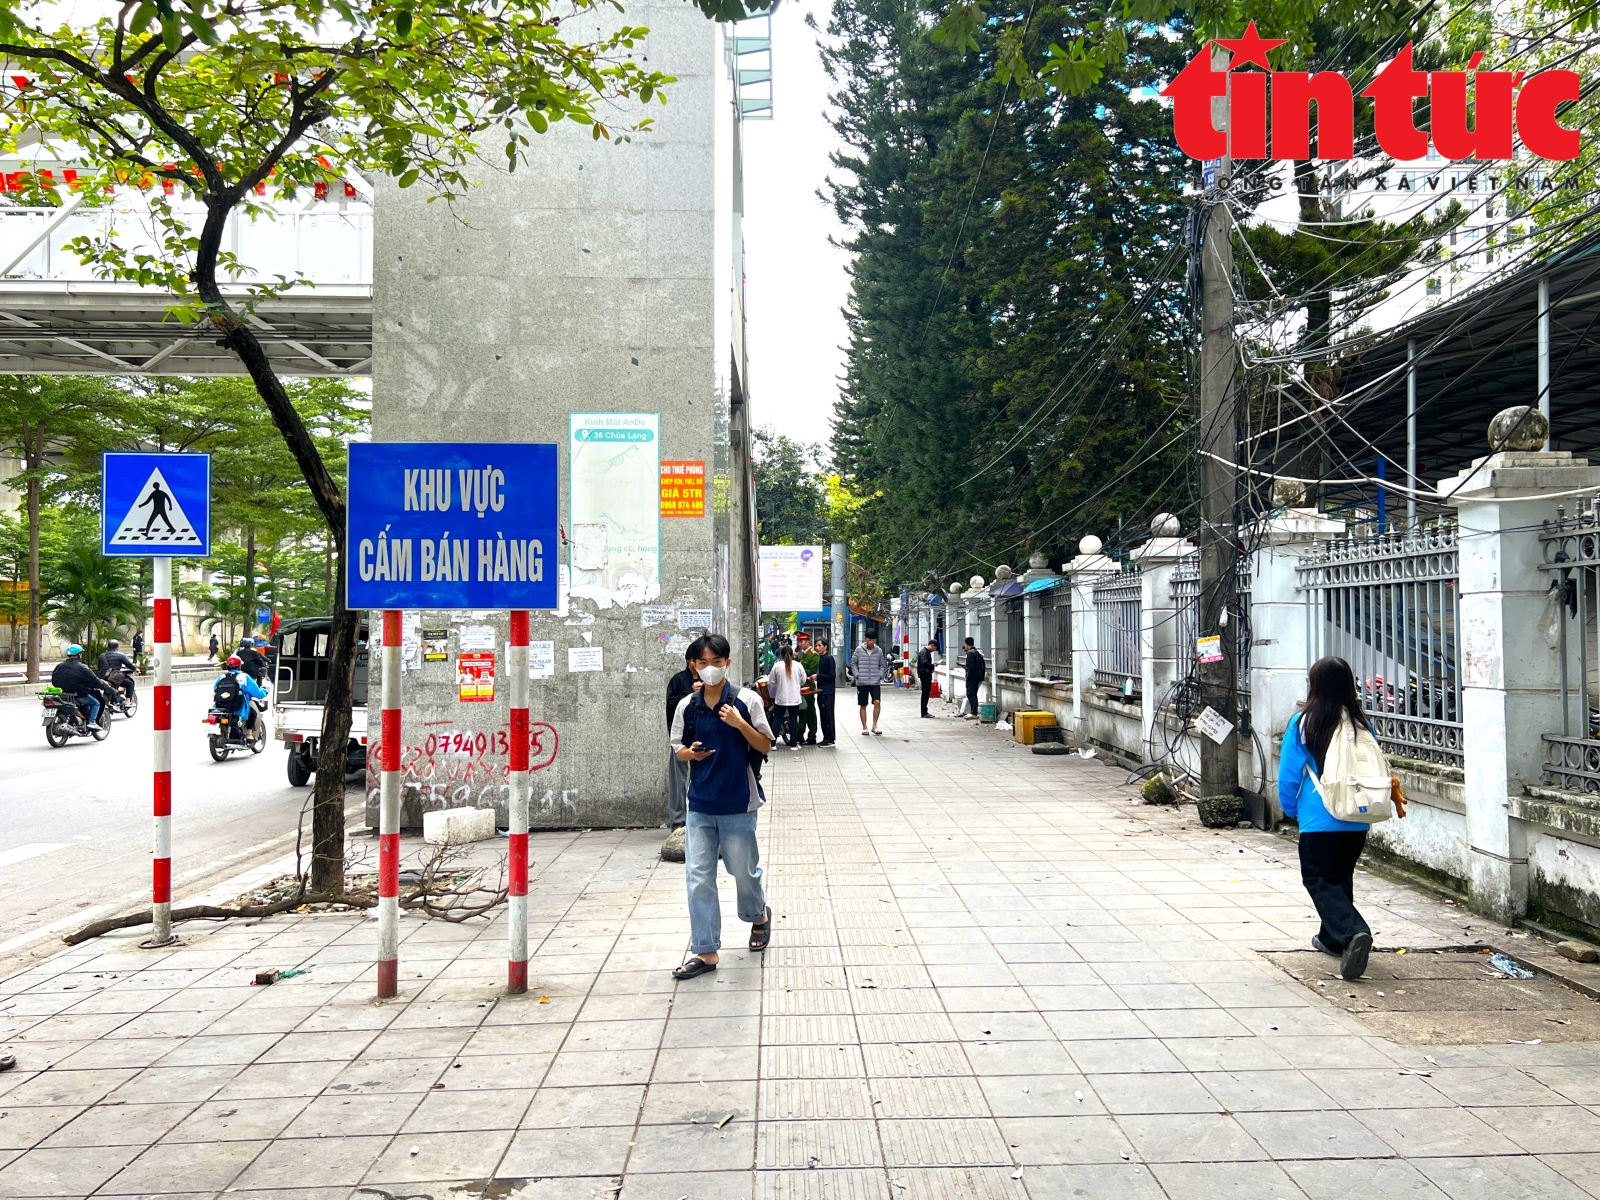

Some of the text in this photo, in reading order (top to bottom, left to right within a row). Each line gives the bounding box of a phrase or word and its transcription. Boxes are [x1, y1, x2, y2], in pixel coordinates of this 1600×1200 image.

[660, 464, 704, 474] CHO THUÊ PHÒNG
[404, 465, 505, 518] KHU VỰC
[661, 487, 703, 498] GIÁ 5TR
[359, 524, 543, 582] CẤM BÁN HÀNG
